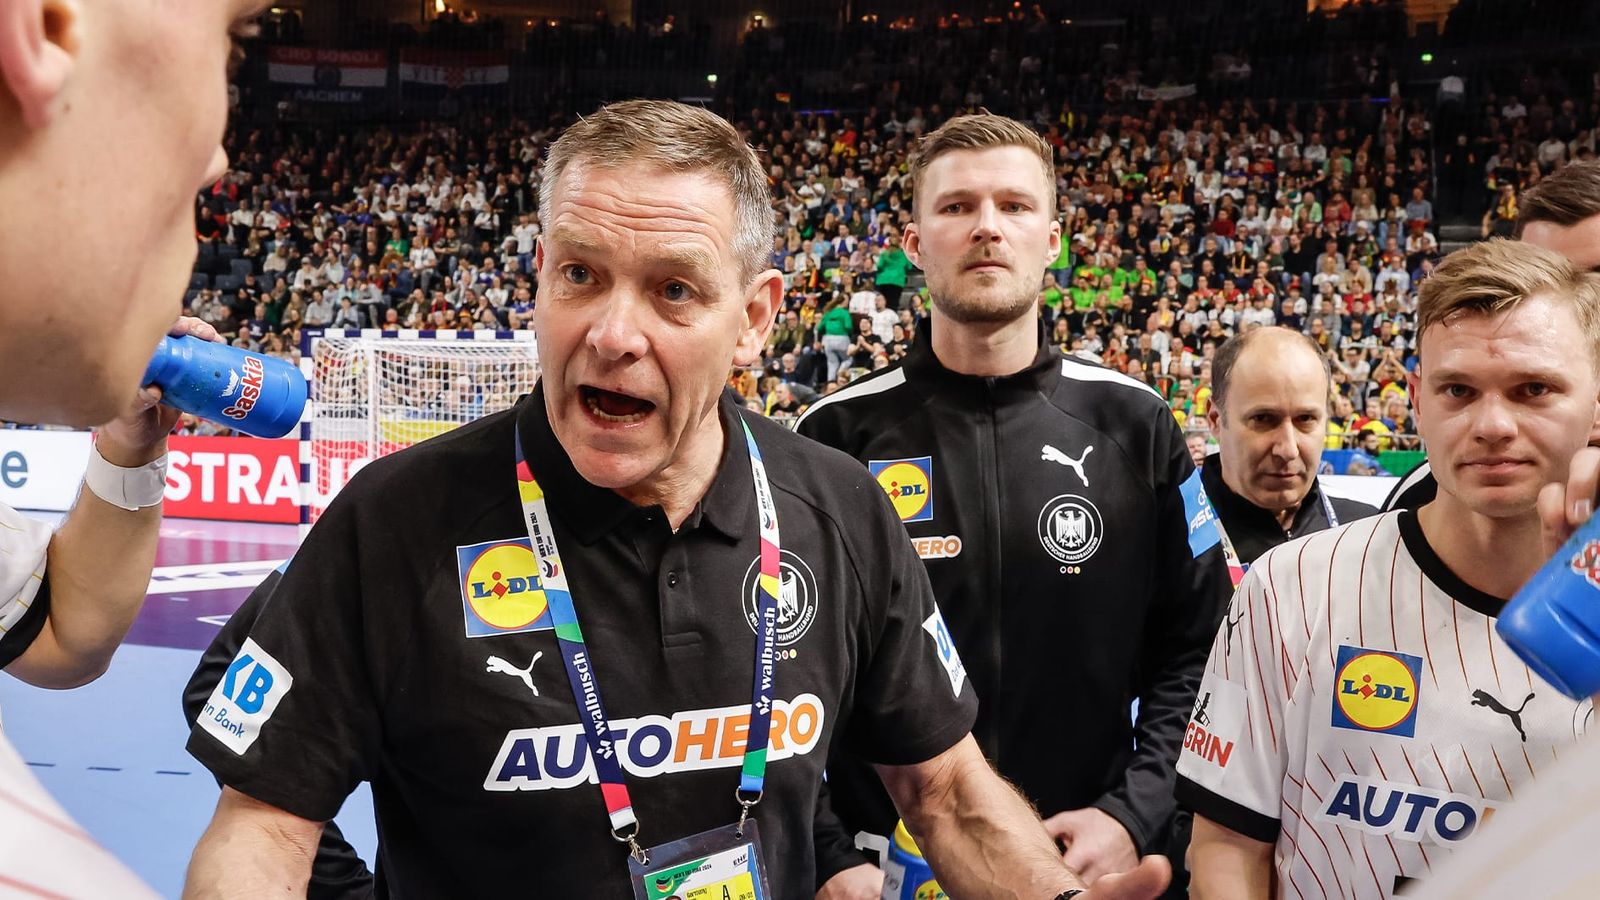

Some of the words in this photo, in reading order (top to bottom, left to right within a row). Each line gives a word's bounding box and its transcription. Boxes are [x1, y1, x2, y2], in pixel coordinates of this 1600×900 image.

[222, 356, 263, 419] Saskia
[761, 607, 776, 691] walbusch
[777, 605, 814, 641] HANDBALLBUND
[214, 708, 245, 738] Bank
[573, 652, 606, 736] walbusch
